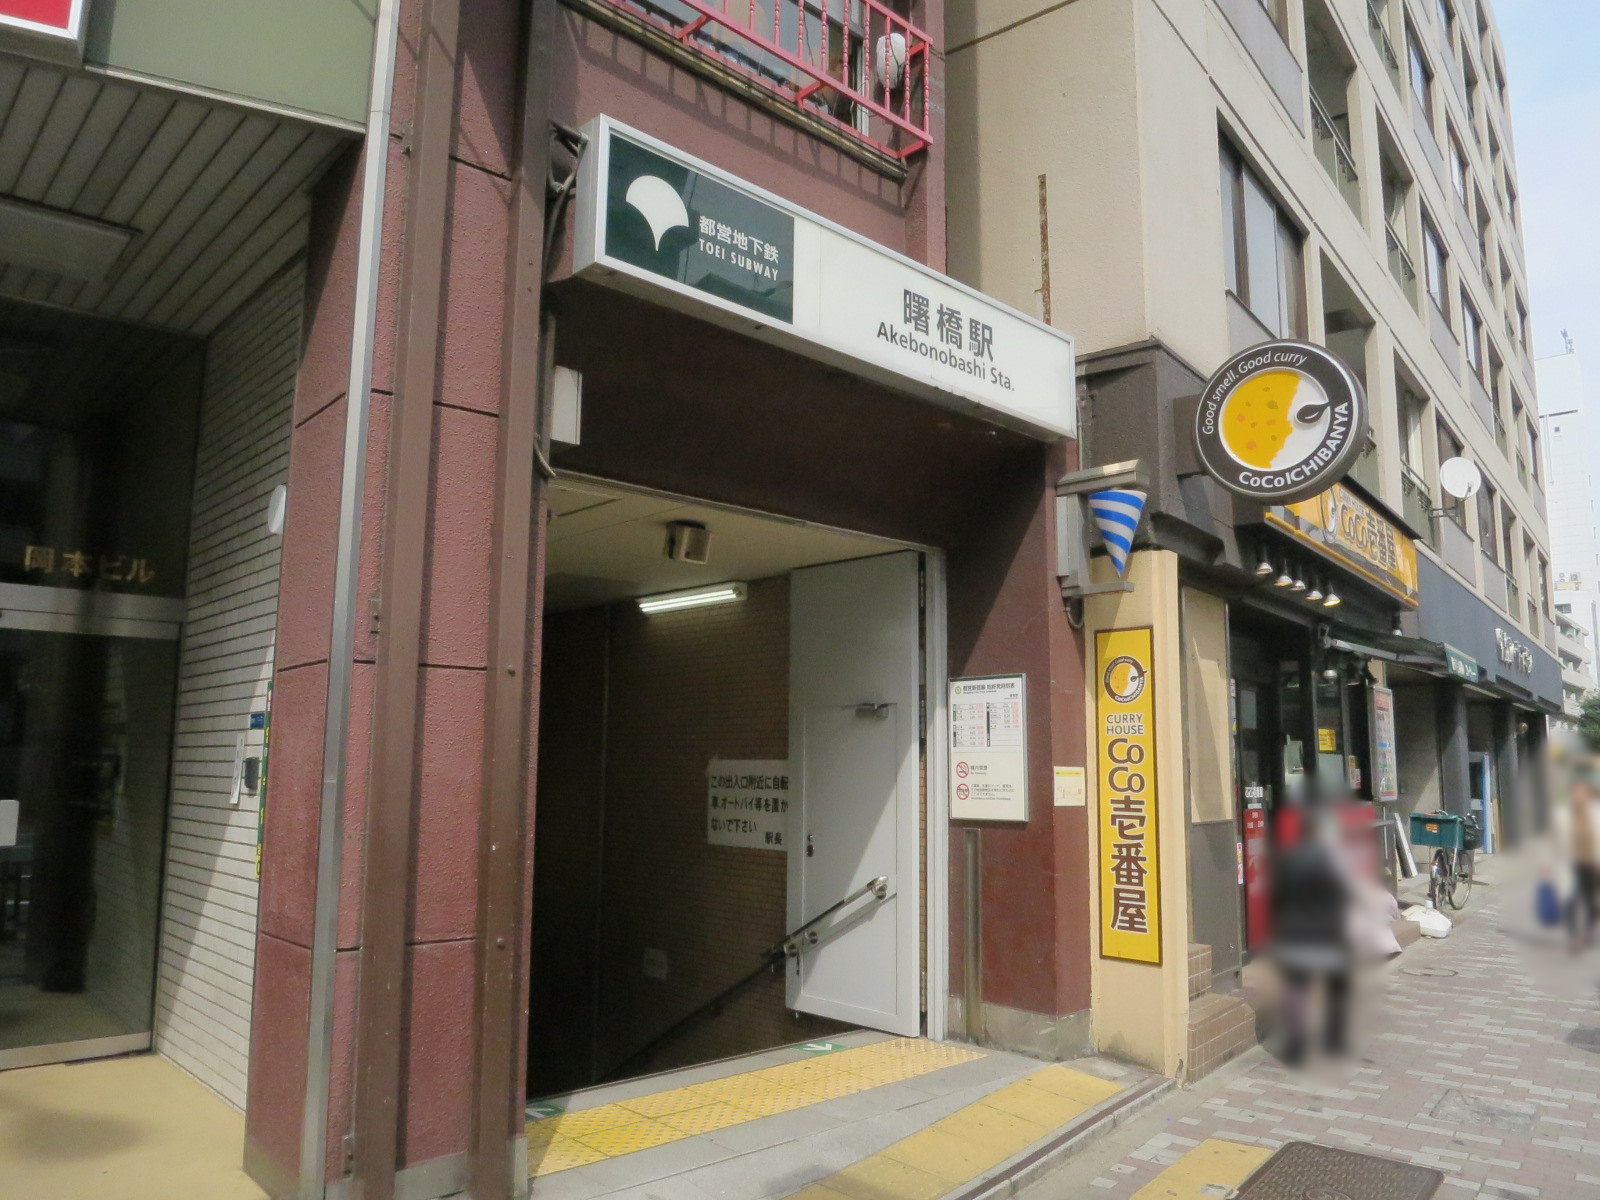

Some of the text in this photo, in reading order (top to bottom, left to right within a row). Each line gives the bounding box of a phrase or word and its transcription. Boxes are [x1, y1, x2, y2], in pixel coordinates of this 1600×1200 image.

[699, 215, 779, 264] 都営地下鉄
[699, 238, 779, 281] TOEI SUBWAY
[903, 288, 994, 362] 曙橋駅
[877, 321, 1015, 392] Akebonobashi Sta.
[1203, 350, 1308, 435] Good smell. Good curry
[1238, 402, 1349, 488] CoCoICHIBANYA
[1106, 714, 1143, 724] CURRY
[1106, 725, 1144, 735] HOUSE
